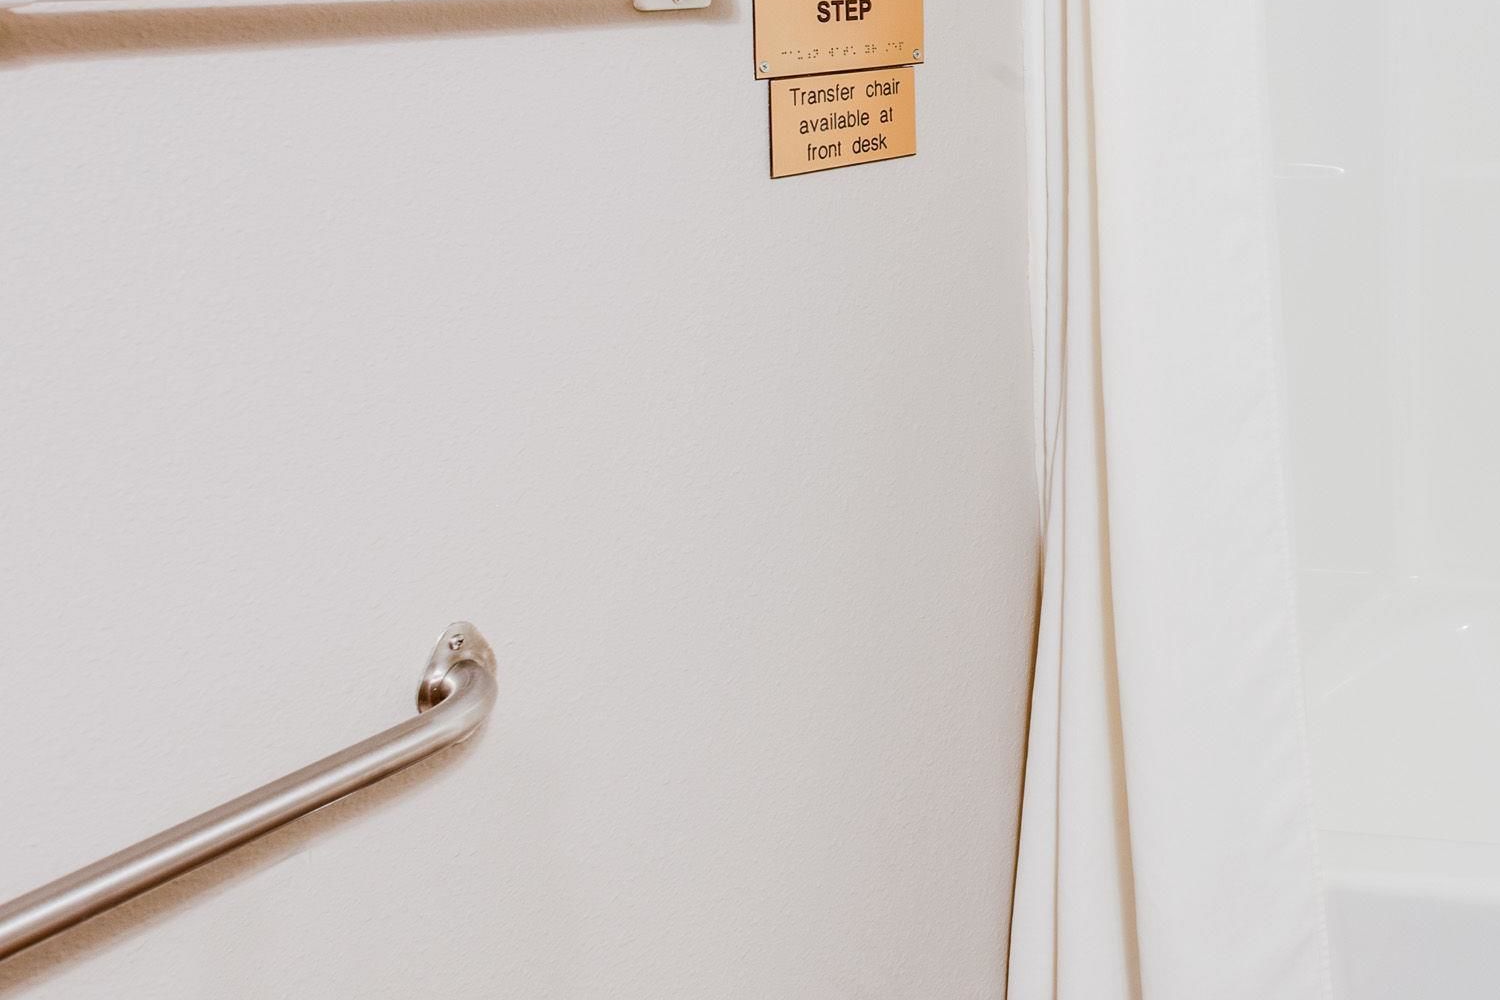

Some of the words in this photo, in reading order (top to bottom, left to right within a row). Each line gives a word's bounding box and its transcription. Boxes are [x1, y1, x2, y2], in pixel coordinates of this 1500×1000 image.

[817, 0, 872, 23] STEP
[789, 84, 855, 106] Transfer
[866, 78, 901, 97] chair
[800, 110, 870, 134] available
[880, 107, 893, 123] at
[808, 141, 842, 161] front
[852, 133, 888, 154] desk
